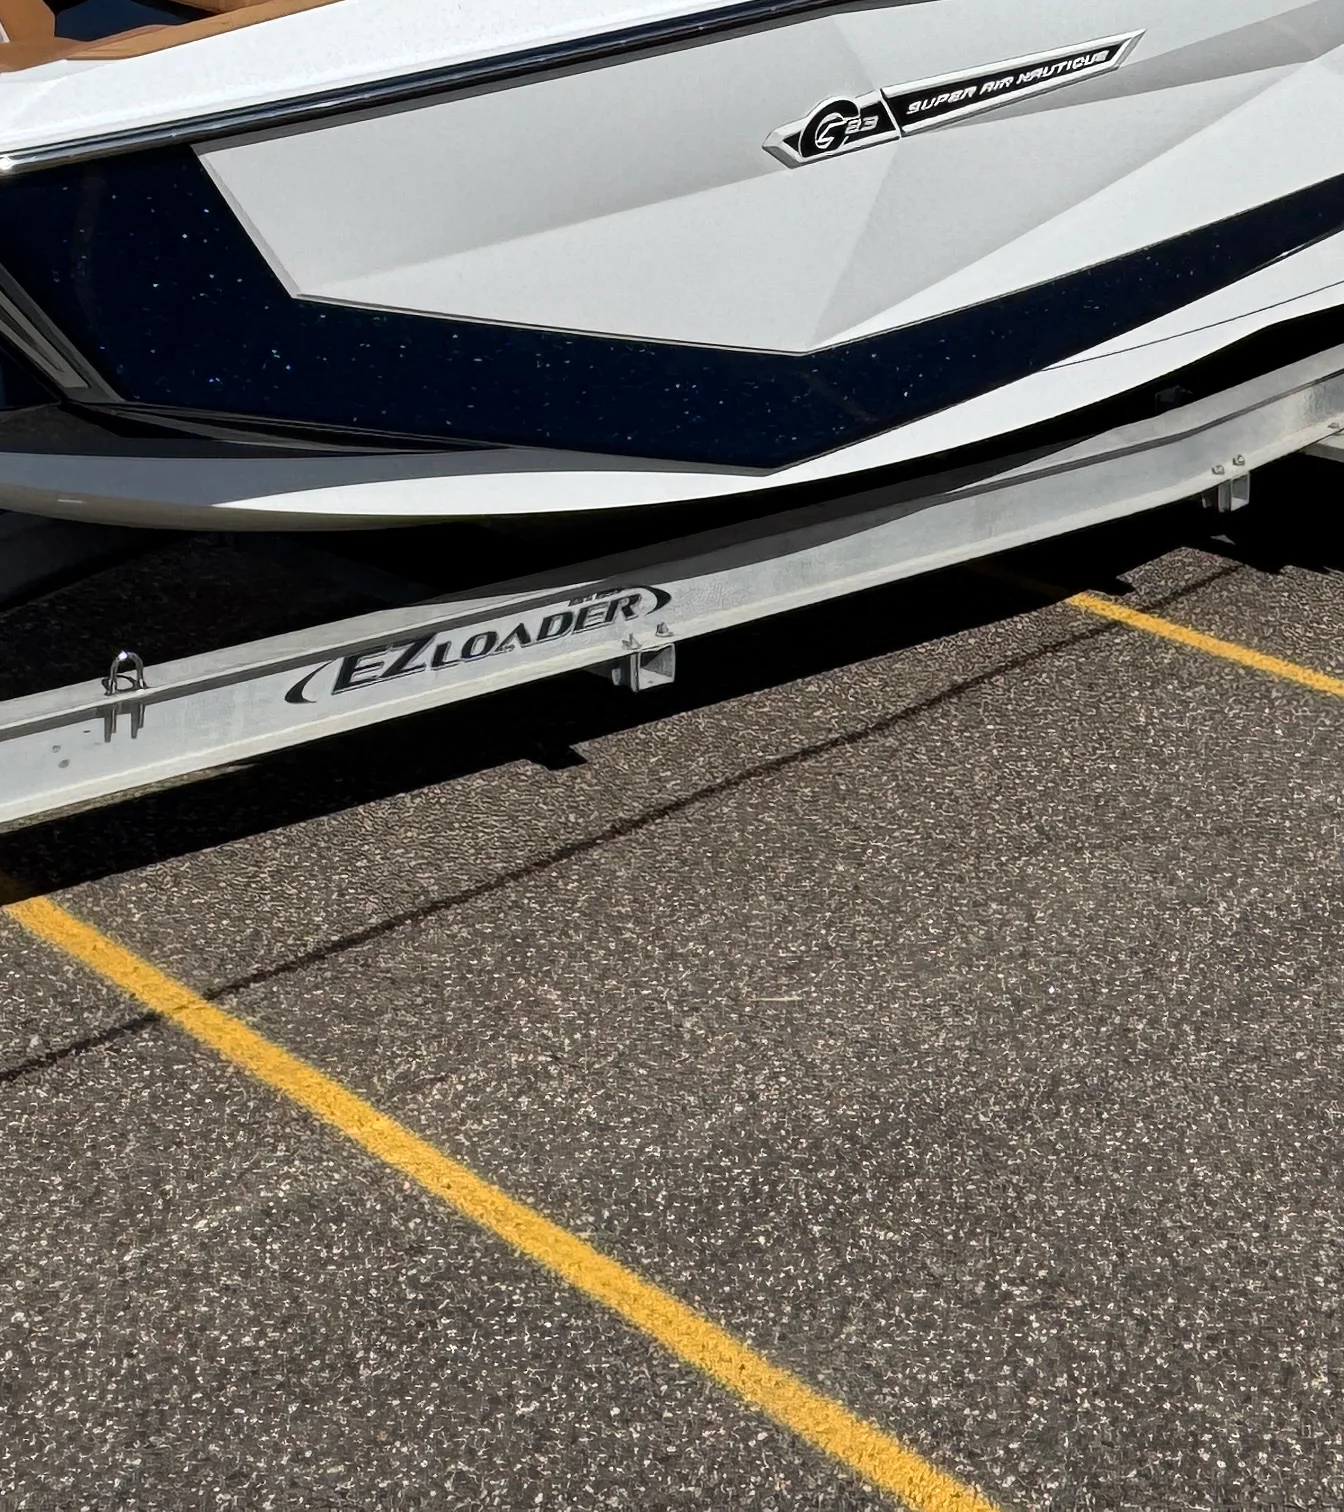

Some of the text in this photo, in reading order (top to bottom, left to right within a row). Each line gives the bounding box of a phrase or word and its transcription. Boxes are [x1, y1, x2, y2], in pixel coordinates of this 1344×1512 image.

[906, 85, 978, 115] SUPER
[979, 76, 1014, 95] AIR
[1016, 49, 1110, 85] NAUTIQUE
